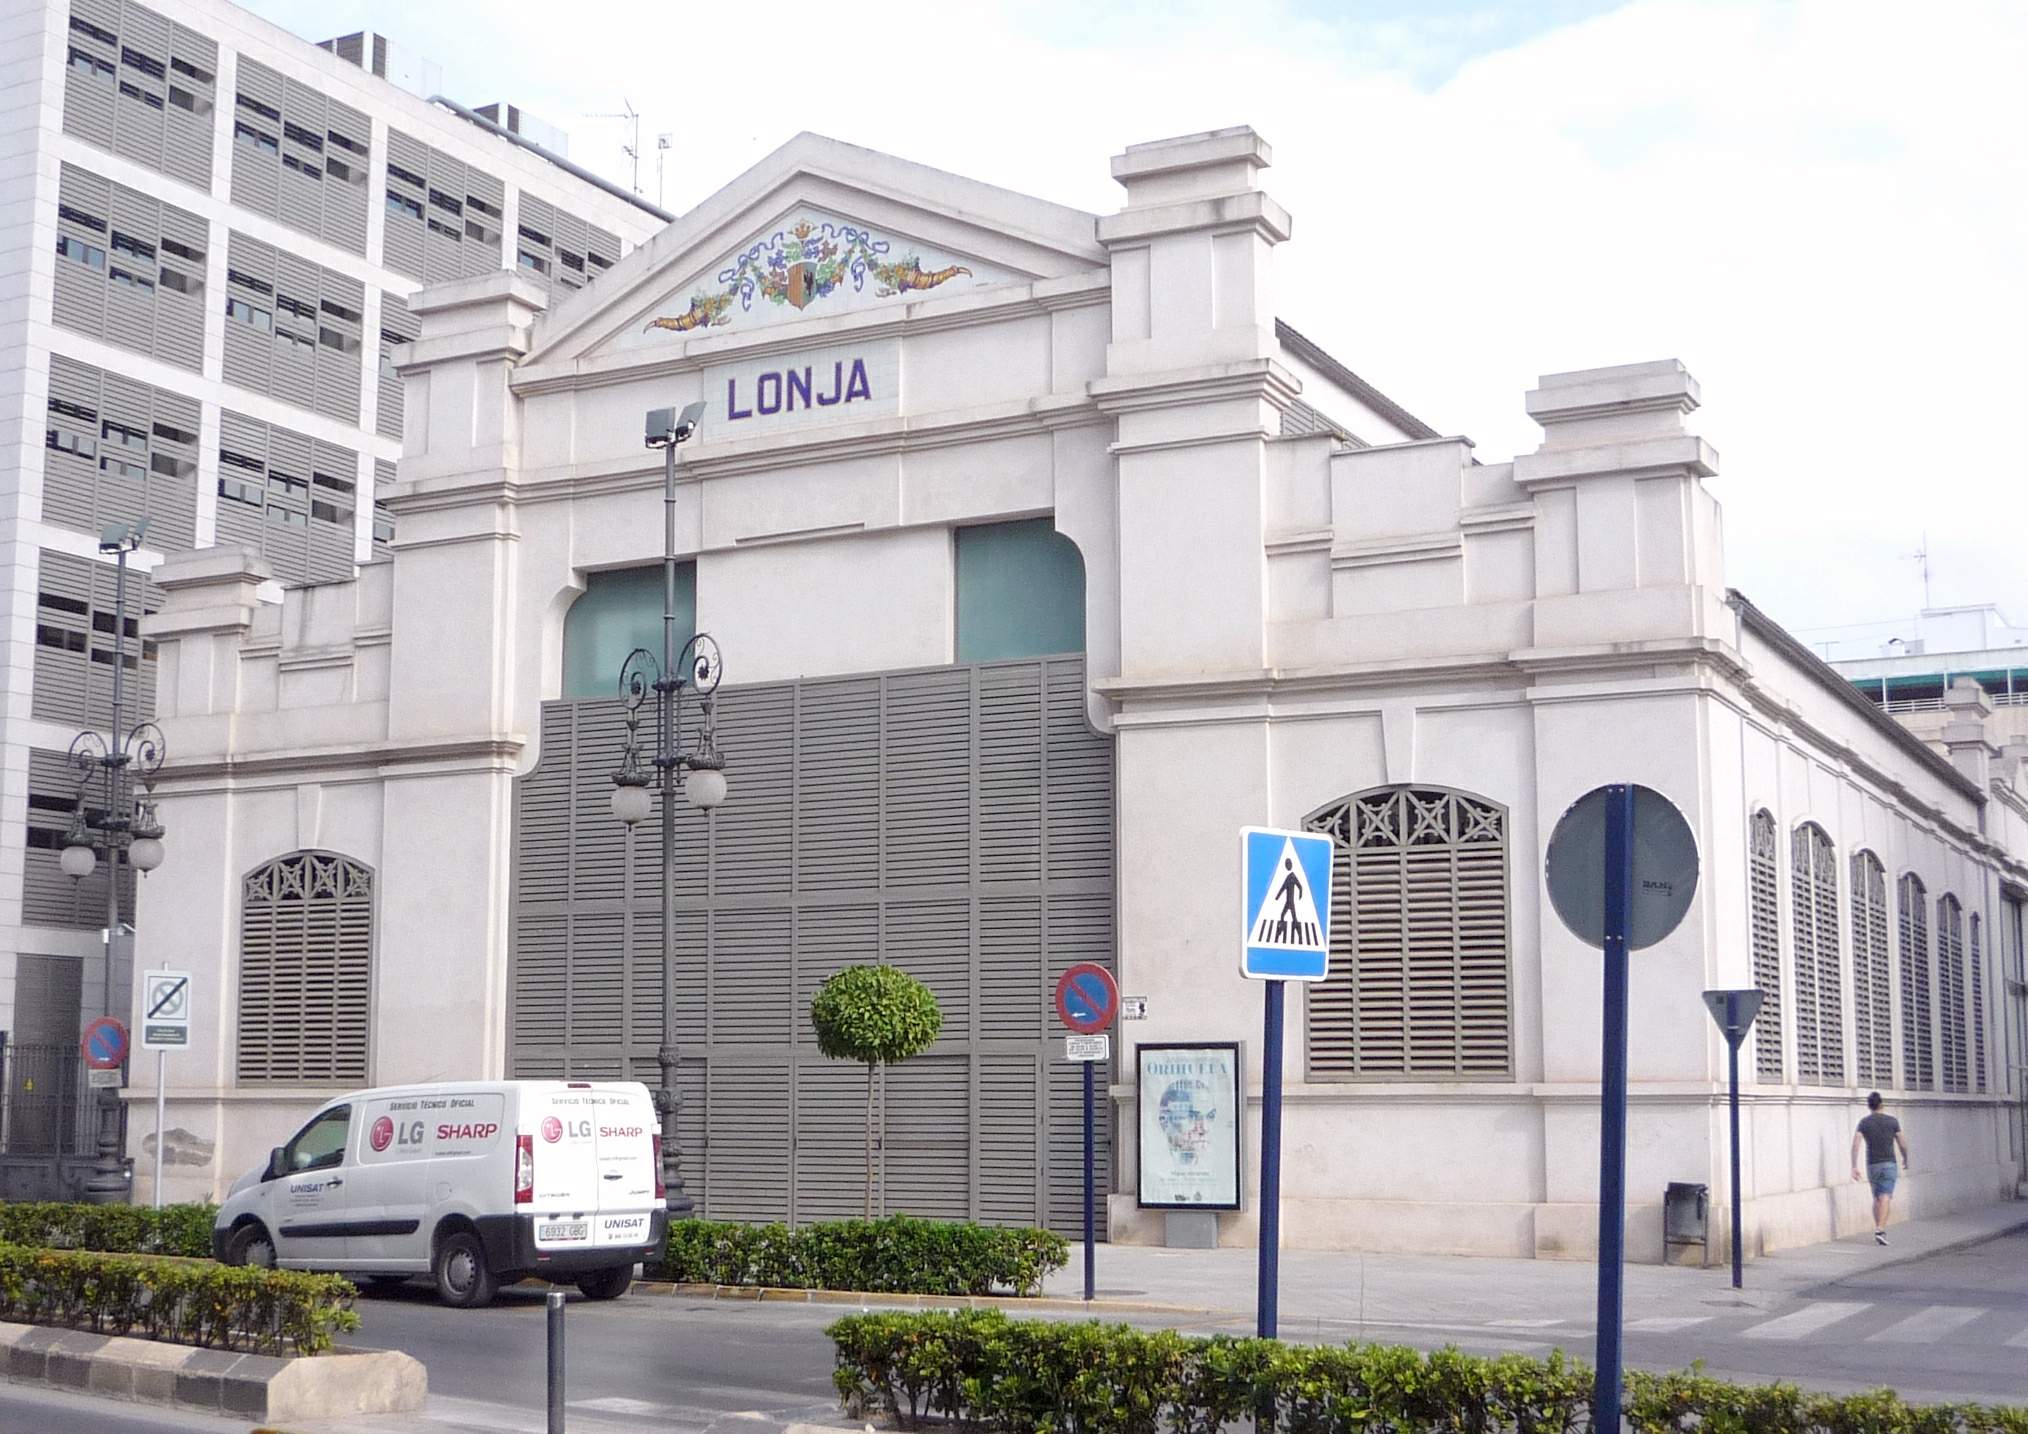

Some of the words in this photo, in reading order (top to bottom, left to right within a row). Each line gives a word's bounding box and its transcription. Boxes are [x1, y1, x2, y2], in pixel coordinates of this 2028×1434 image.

[728, 358, 871, 420] LONJA
[450, 1099, 475, 1108] OFICIAL
[398, 1121, 425, 1144] LG
[437, 1124, 497, 1140] SHARP
[568, 1120, 592, 1138] LG
[600, 1126, 643, 1138] SHARP
[290, 1183, 324, 1193] UNISAT
[604, 1218, 644, 1229] UNISAT
[545, 1226, 566, 1238] 6932
